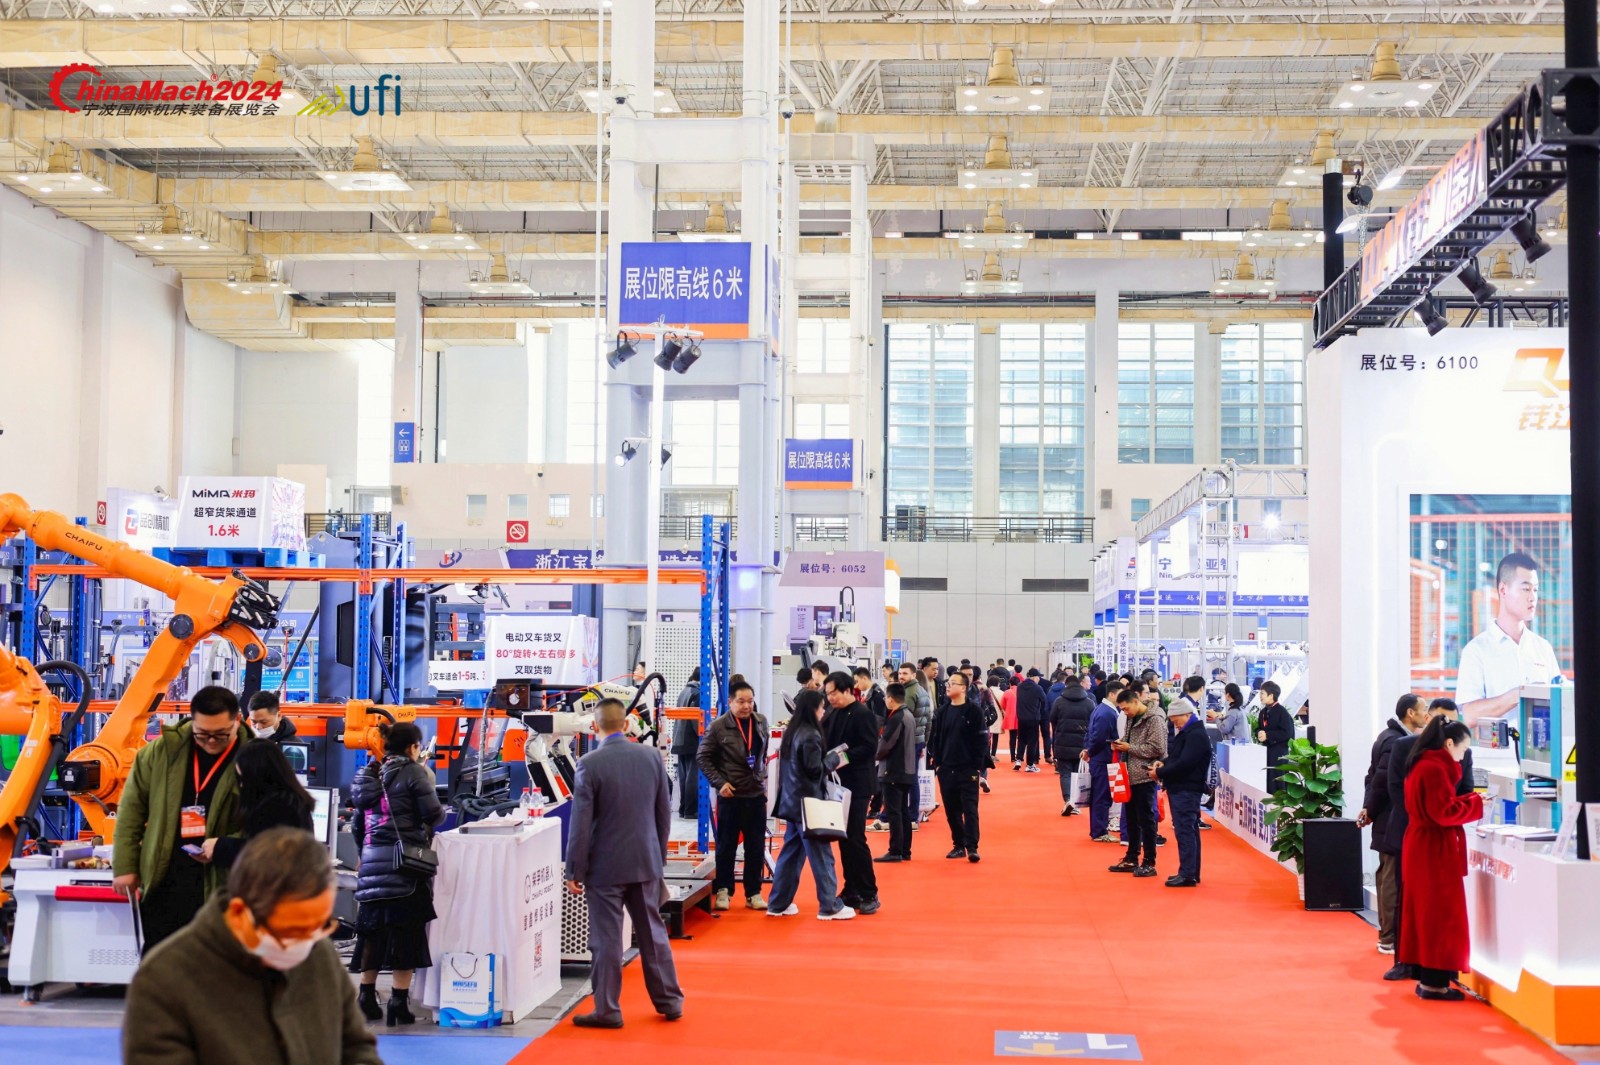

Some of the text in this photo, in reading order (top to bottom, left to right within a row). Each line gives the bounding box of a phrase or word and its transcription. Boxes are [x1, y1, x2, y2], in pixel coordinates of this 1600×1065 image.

[624, 266, 743, 300] 展位限高线6米
[787, 451, 851, 469] 展位限高线6米
[193, 506, 257, 518] 超窄货架通道
[208, 524, 240, 537] 1.6米
[65, 532, 103, 551] CHAIFU
[505, 633, 562, 642] 电动叉车货叉
[515, 665, 552, 674] 叉取货物
